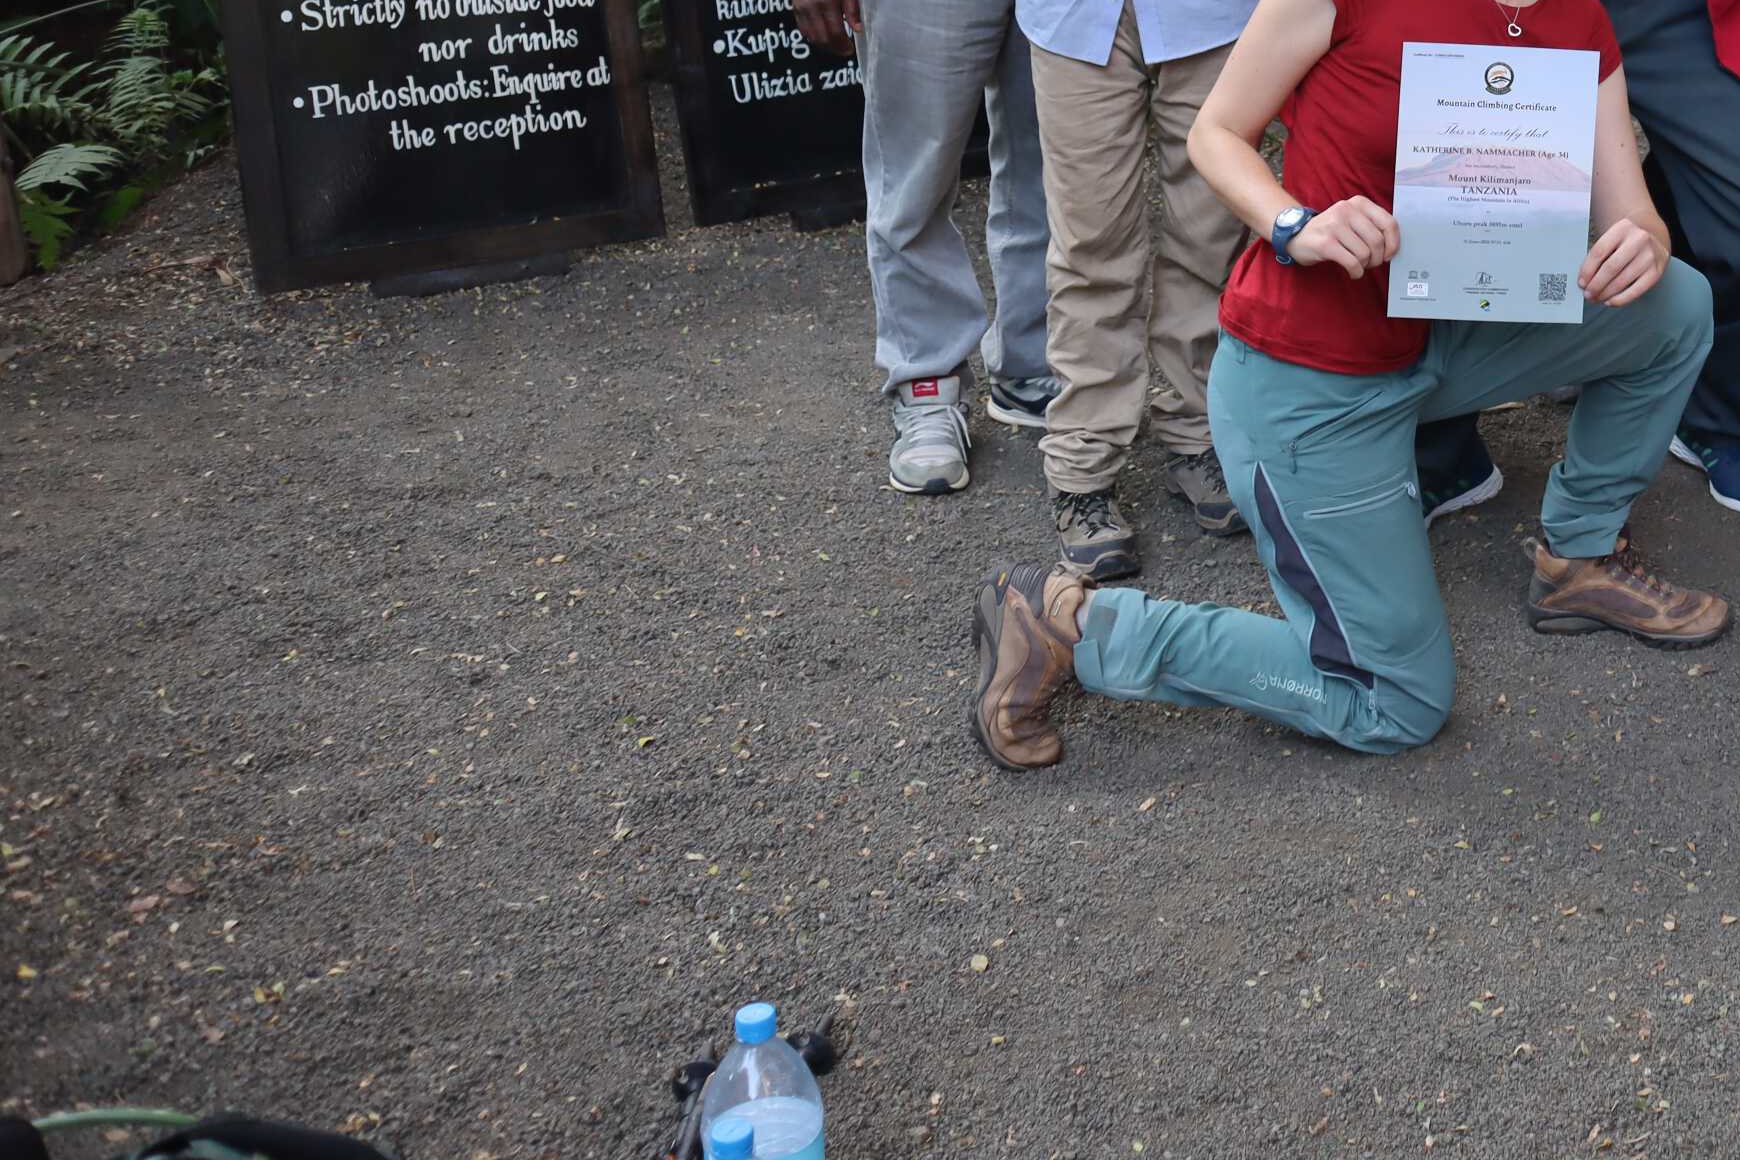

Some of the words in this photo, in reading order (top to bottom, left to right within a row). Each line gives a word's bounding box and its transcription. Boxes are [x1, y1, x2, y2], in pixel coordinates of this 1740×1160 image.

[419, 35, 472, 64] nor
[487, 19, 579, 57] drinks
[725, 23, 810, 63] Kupig
[308, 71, 491, 120] Photoshoots:
[492, 63, 583, 104] Enquire
[587, 56, 612, 86] at
[729, 67, 813, 104] Ulizia
[1437, 99, 1475, 108] Mountain
[1477, 101, 1513, 111] Climbing
[1515, 102, 1557, 112] Certificate
[389, 118, 436, 151] the
[443, 102, 587, 150] reception
[1448, 174, 1477, 183] Mount
[1480, 175, 1531, 185] Kilimanjaro
[1461, 186, 1517, 196] TANZANIA
